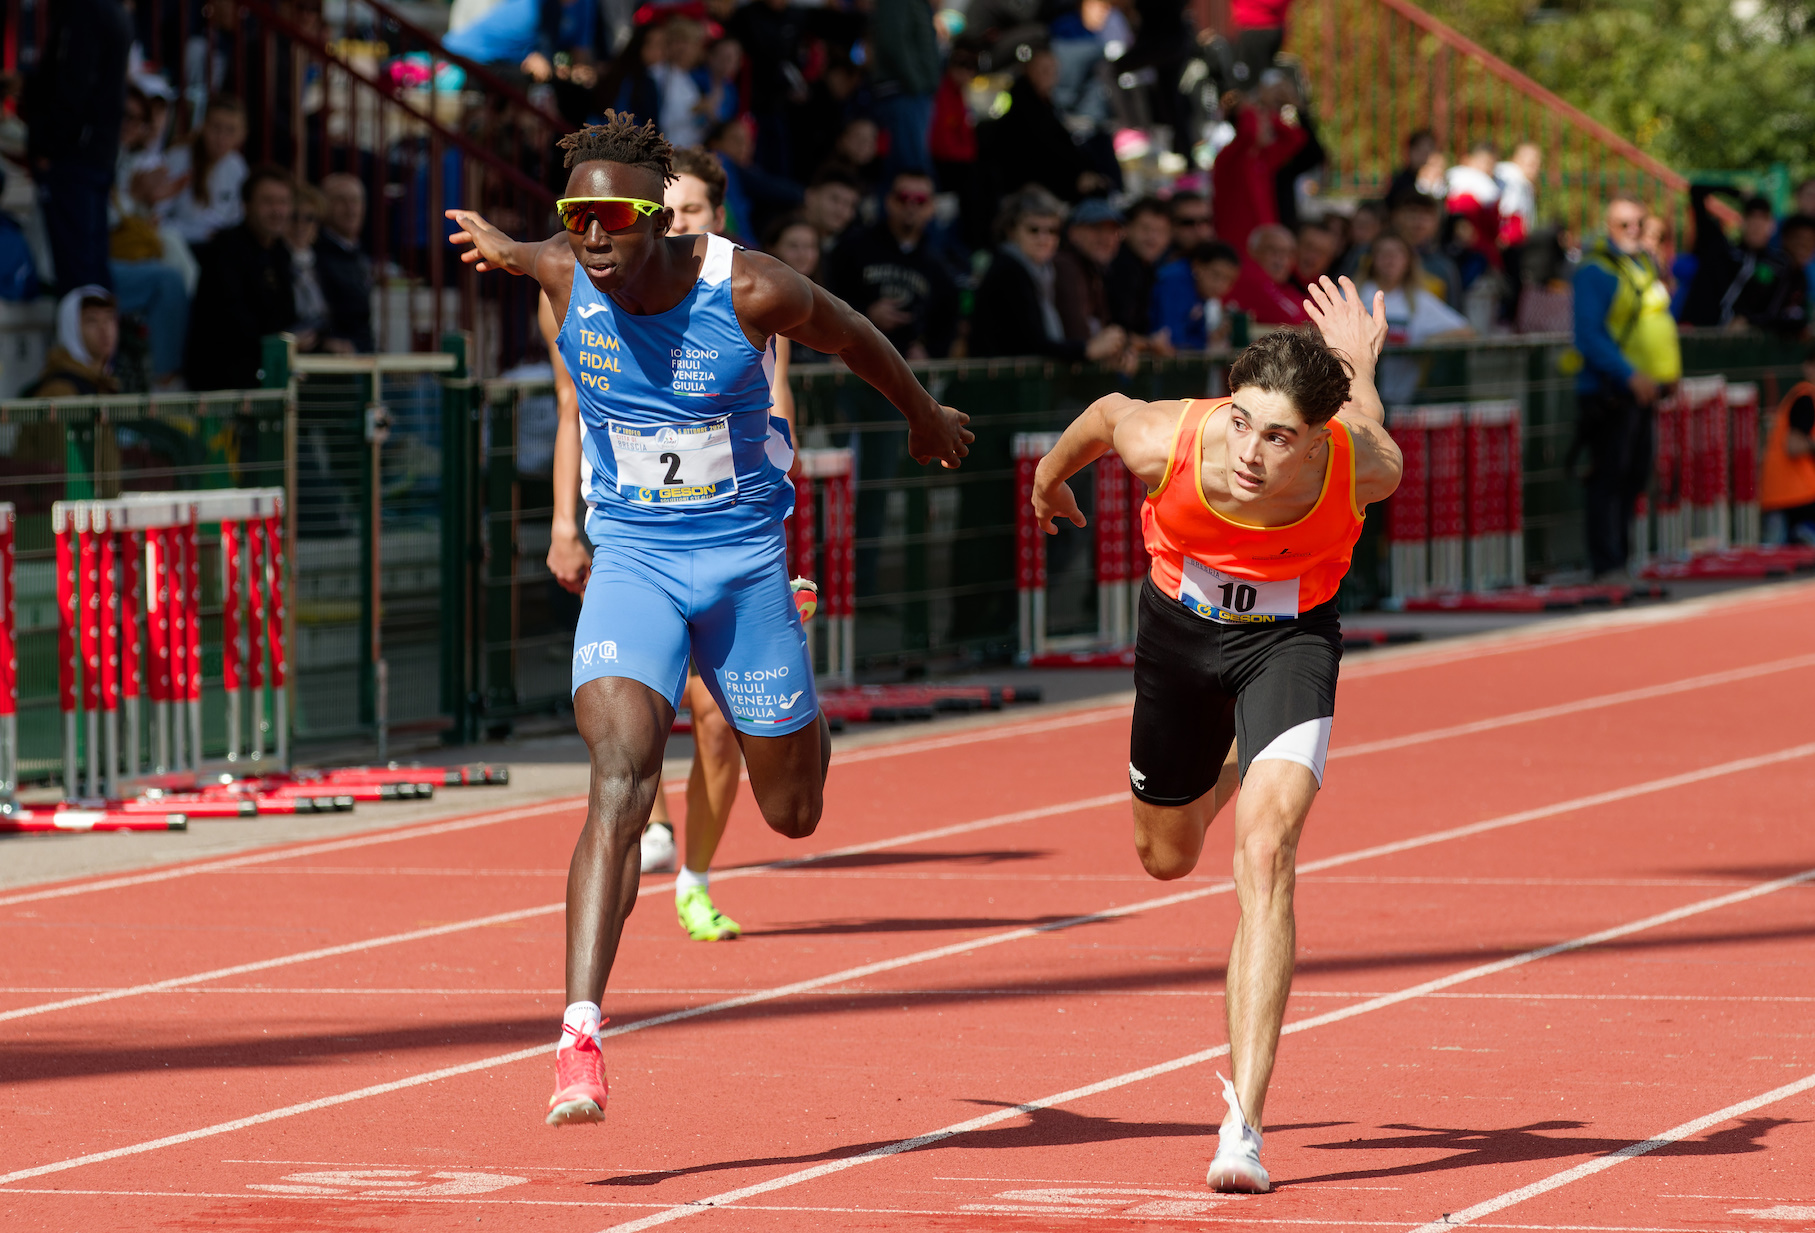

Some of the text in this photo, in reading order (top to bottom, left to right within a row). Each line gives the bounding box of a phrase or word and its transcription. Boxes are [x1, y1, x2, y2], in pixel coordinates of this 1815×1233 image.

[580, 329, 620, 351] TEAM
[670, 348, 719, 360] IO SONO
[580, 351, 621, 373] FIDAL
[671, 359, 700, 370] FRIULI
[580, 371, 610, 392] FVG
[671, 369, 716, 381] VENEZIA
[672, 380, 707, 391] GIULIA
[683, 426, 708, 435] OTTOBRE
[617, 440, 647, 452] BRESCIA
[659, 452, 684, 485] 2
[659, 484, 717, 499] GESON
[1217, 582, 1257, 613] 10
[1218, 609, 1276, 623] GESON
[725, 666, 789, 681] IO SONO
[726, 681, 764, 694] FRIULI
[728, 693, 788, 706] VENEZIA
[733, 705, 776, 718] GIULIA
